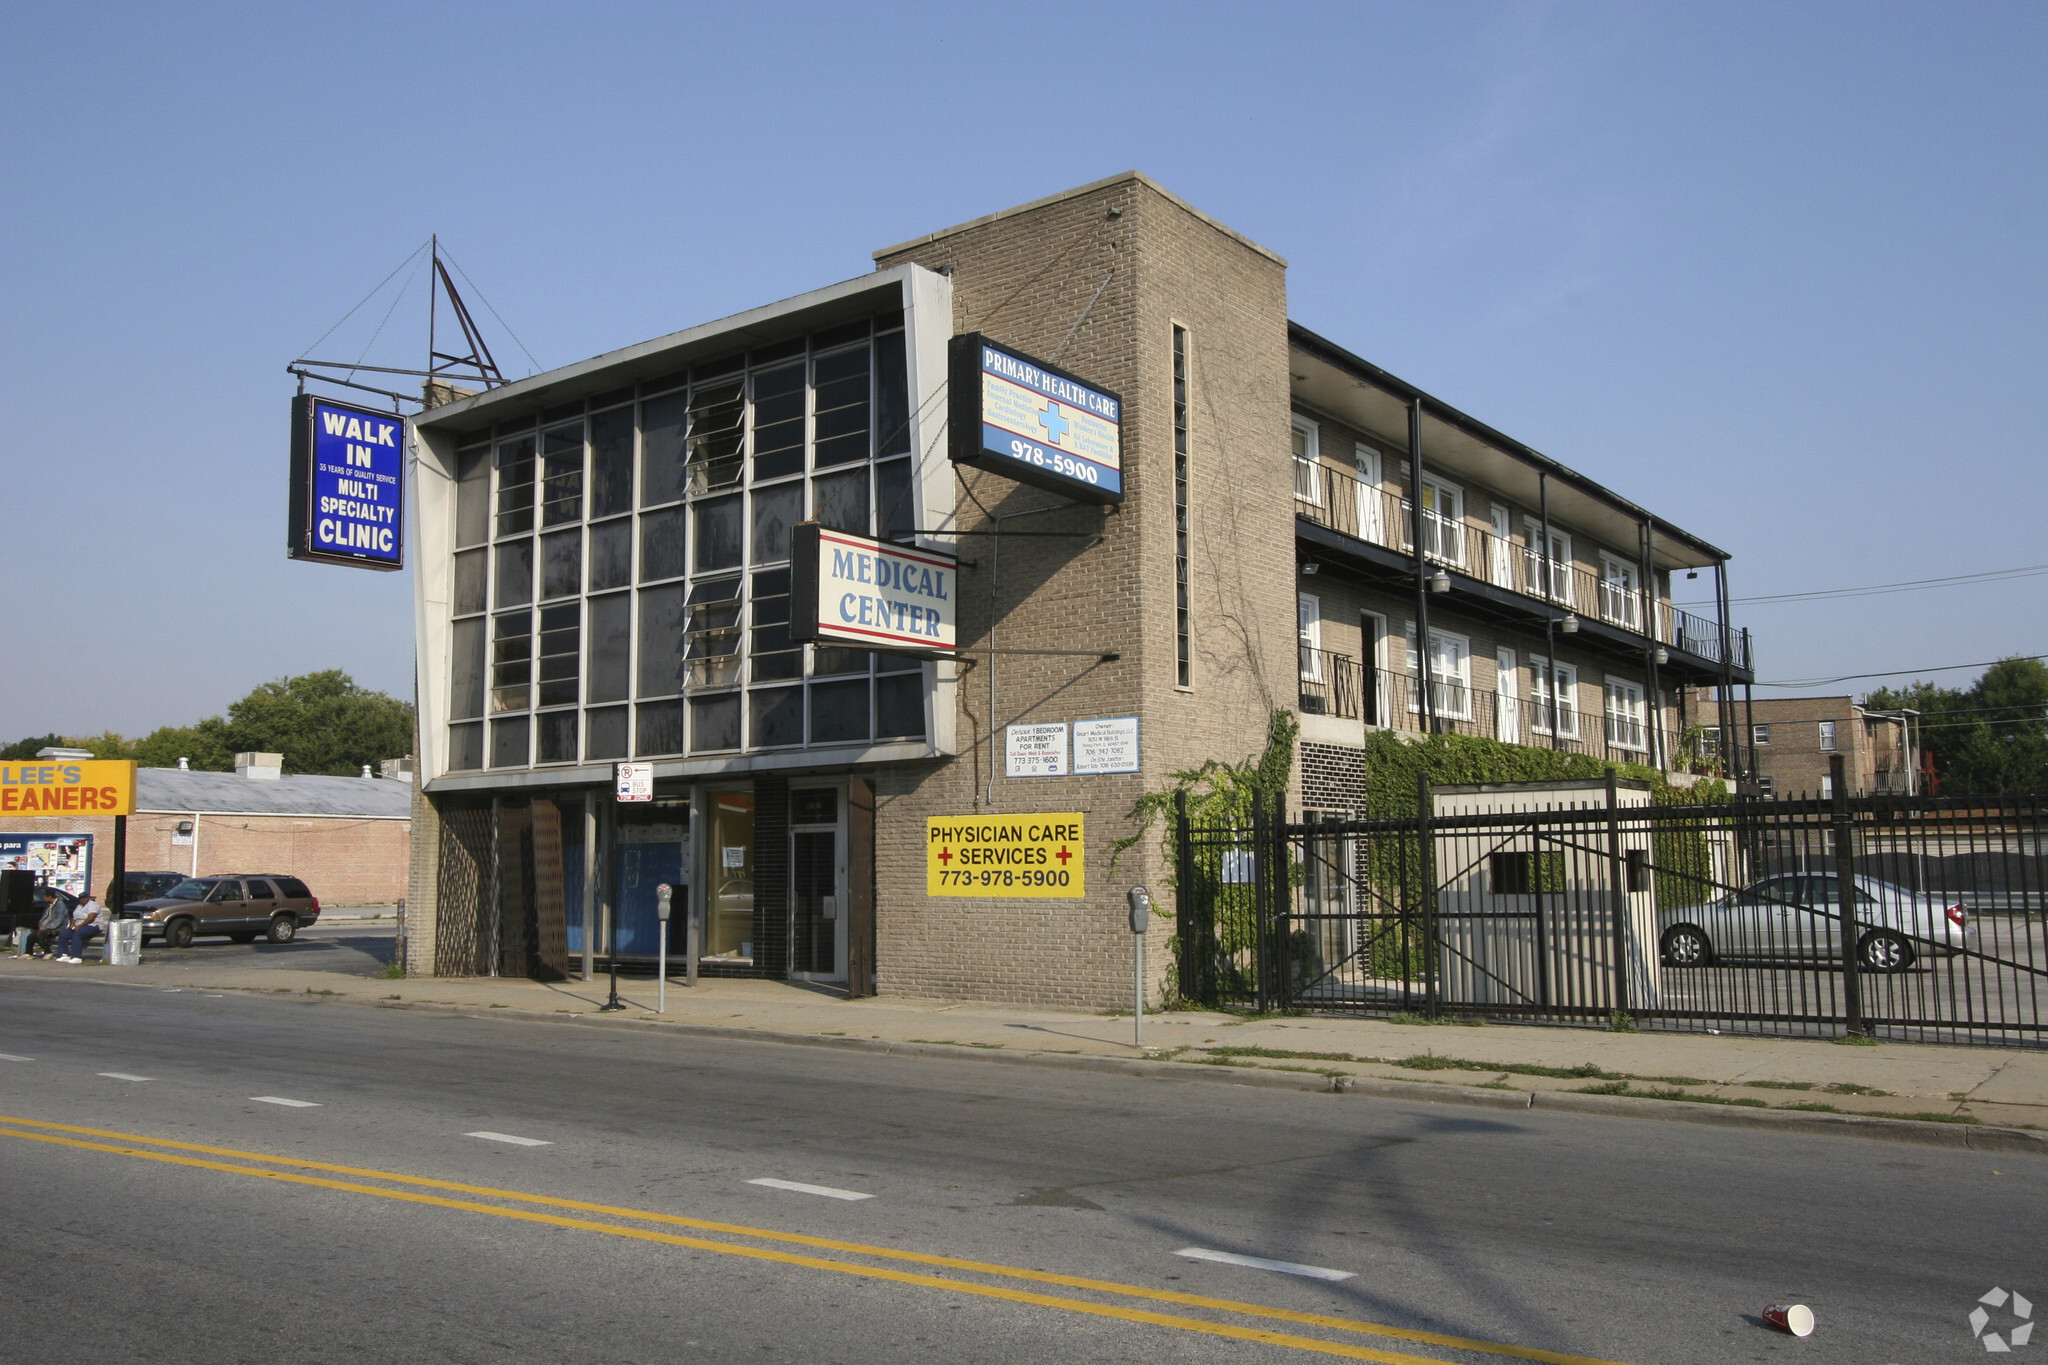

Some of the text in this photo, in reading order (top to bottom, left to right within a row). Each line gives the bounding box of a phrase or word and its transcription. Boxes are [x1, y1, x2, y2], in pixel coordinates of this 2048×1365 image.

[986, 350, 1115, 418] PRIMARY HEALTH CARE
[987, 390, 1011, 404] Internal
[995, 402, 1026, 420] Cardiology
[323, 412, 395, 447] WALK
[347, 444, 371, 468] IN
[1011, 440, 1098, 484] 978-5900
[320, 463, 396, 484] 35 YEARS OF QUALITY SERVICE
[338, 478, 378, 500] MULTI
[321, 496, 394, 523] SPECIALTY
[319, 518, 393, 552] CLINIC
[832, 548, 947, 601] MEDICAL
[840, 593, 940, 637] CENTER
[1028, 756, 1058, 764] 375-1600
[2, 765, 81, 785] LEE'S
[931, 825, 1079, 843] PHYSICIAN CARE
[960, 848, 1047, 864] SERVICES
[940, 870, 1069, 886] 773-978-5900
